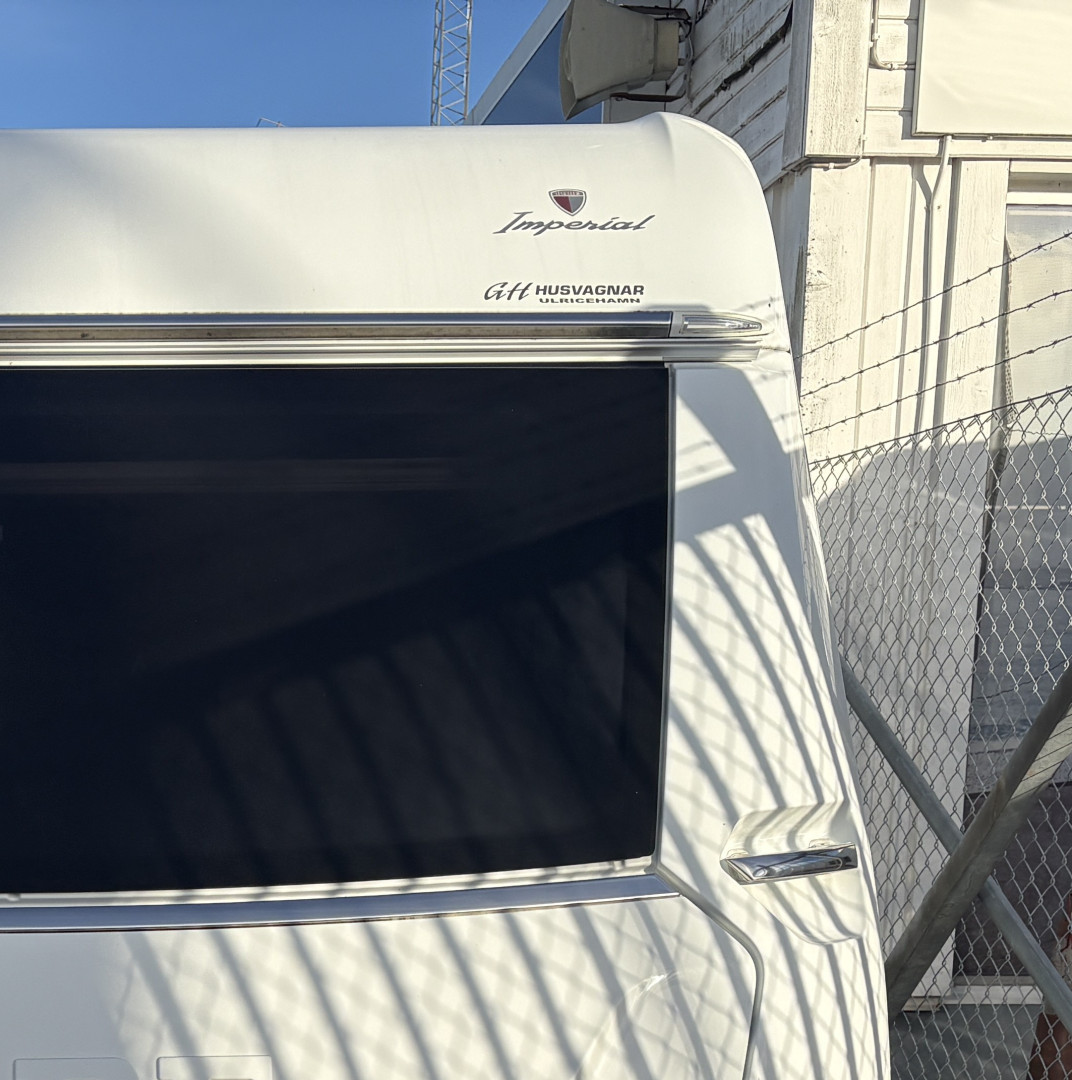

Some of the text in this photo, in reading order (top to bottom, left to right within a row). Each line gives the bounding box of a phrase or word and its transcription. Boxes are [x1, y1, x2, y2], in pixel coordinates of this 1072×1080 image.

[492, 211, 656, 236] Imperial
[483, 282, 645, 301] GH HUSVAGNAR
